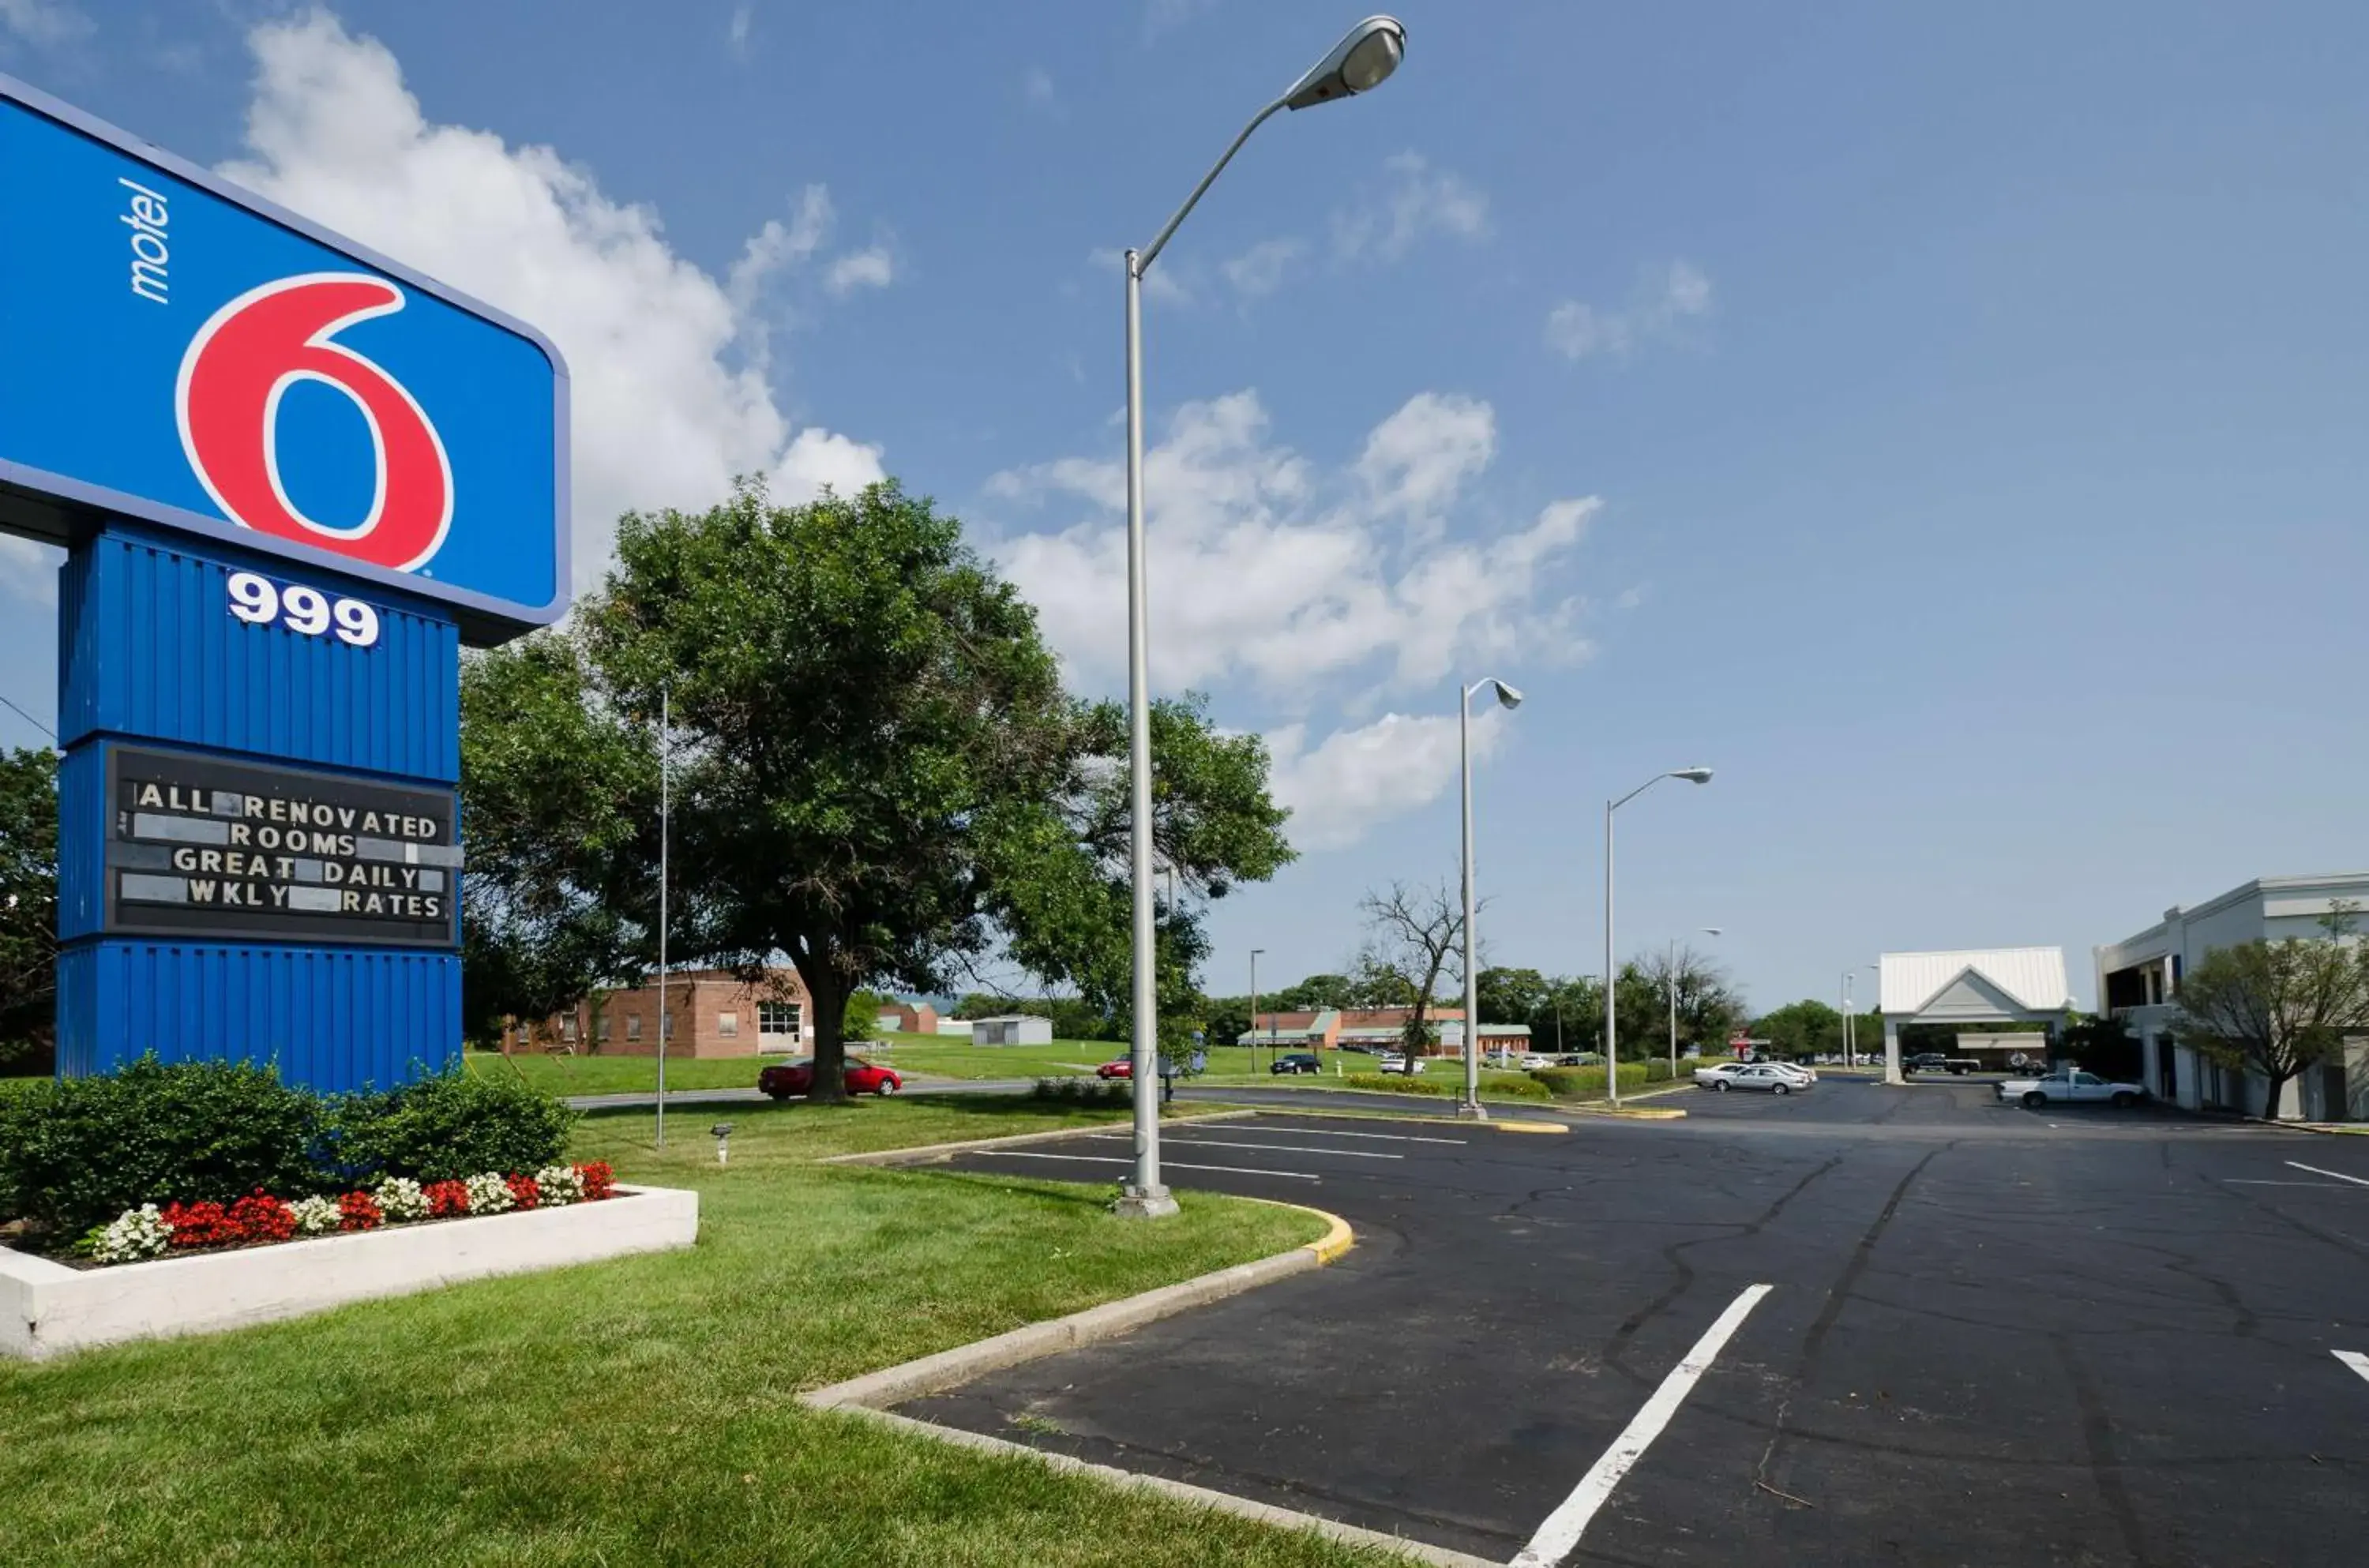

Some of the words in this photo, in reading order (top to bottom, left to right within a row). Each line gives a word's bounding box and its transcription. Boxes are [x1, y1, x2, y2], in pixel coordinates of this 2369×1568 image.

[118, 177, 168, 305] motel
[175, 272, 455, 574] 6
[227, 572, 380, 647] 999
[139, 783, 210, 812] ALL
[244, 795, 437, 838] RENOVATED
[231, 823, 355, 856] ROOMS
[174, 847, 294, 879] GREAT
[325, 861, 417, 888] DAILY
[189, 878, 288, 907] WKLY
[343, 890, 440, 917] RATES
